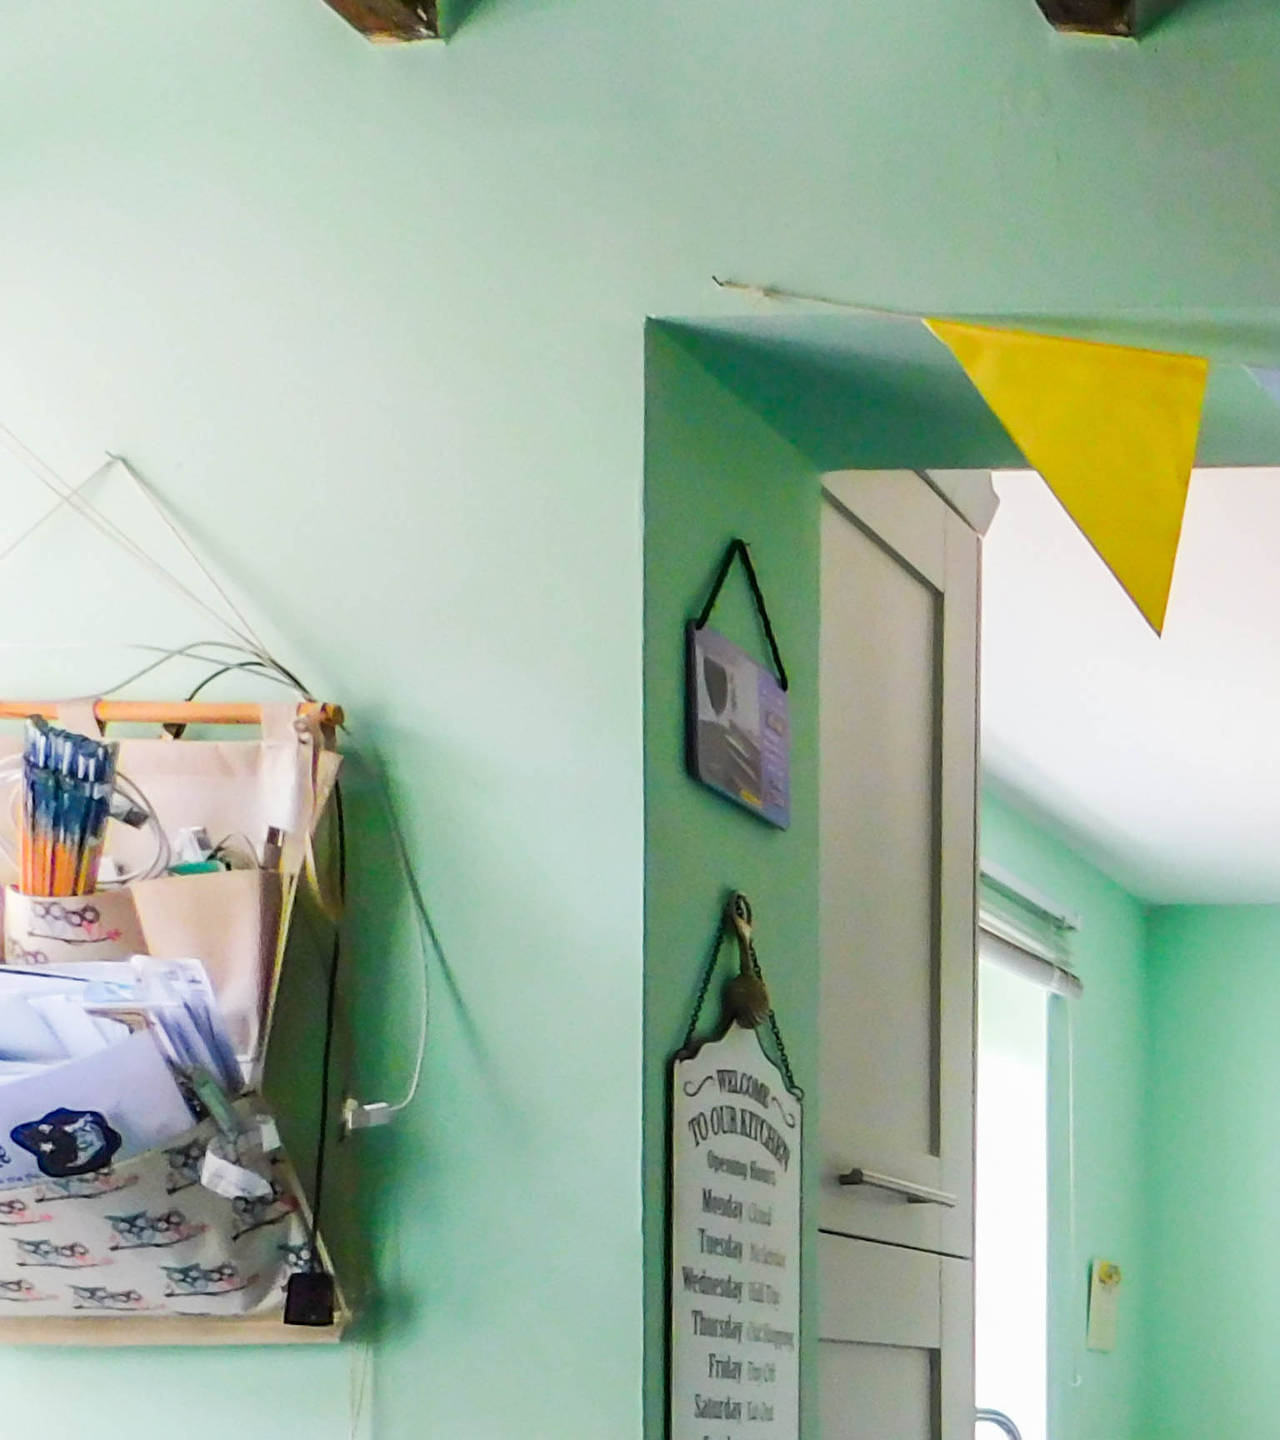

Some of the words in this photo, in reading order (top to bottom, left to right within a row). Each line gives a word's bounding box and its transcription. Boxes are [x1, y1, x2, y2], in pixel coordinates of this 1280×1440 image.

[716, 1069, 770, 1109] WELCOME
[688, 1111, 708, 1148] TO
[711, 1105, 737, 1135] OUR
[740, 1108, 790, 1173] KITCHEN
[702, 1187, 743, 1223] Monday
[697, 1228, 743, 1263] Tuesday
[681, 1266, 743, 1303] Wednesday
[691, 1310, 743, 1343] Thursday
[708, 1353, 742, 1384] Friday
[694, 1394, 742, 1423] Saturday
